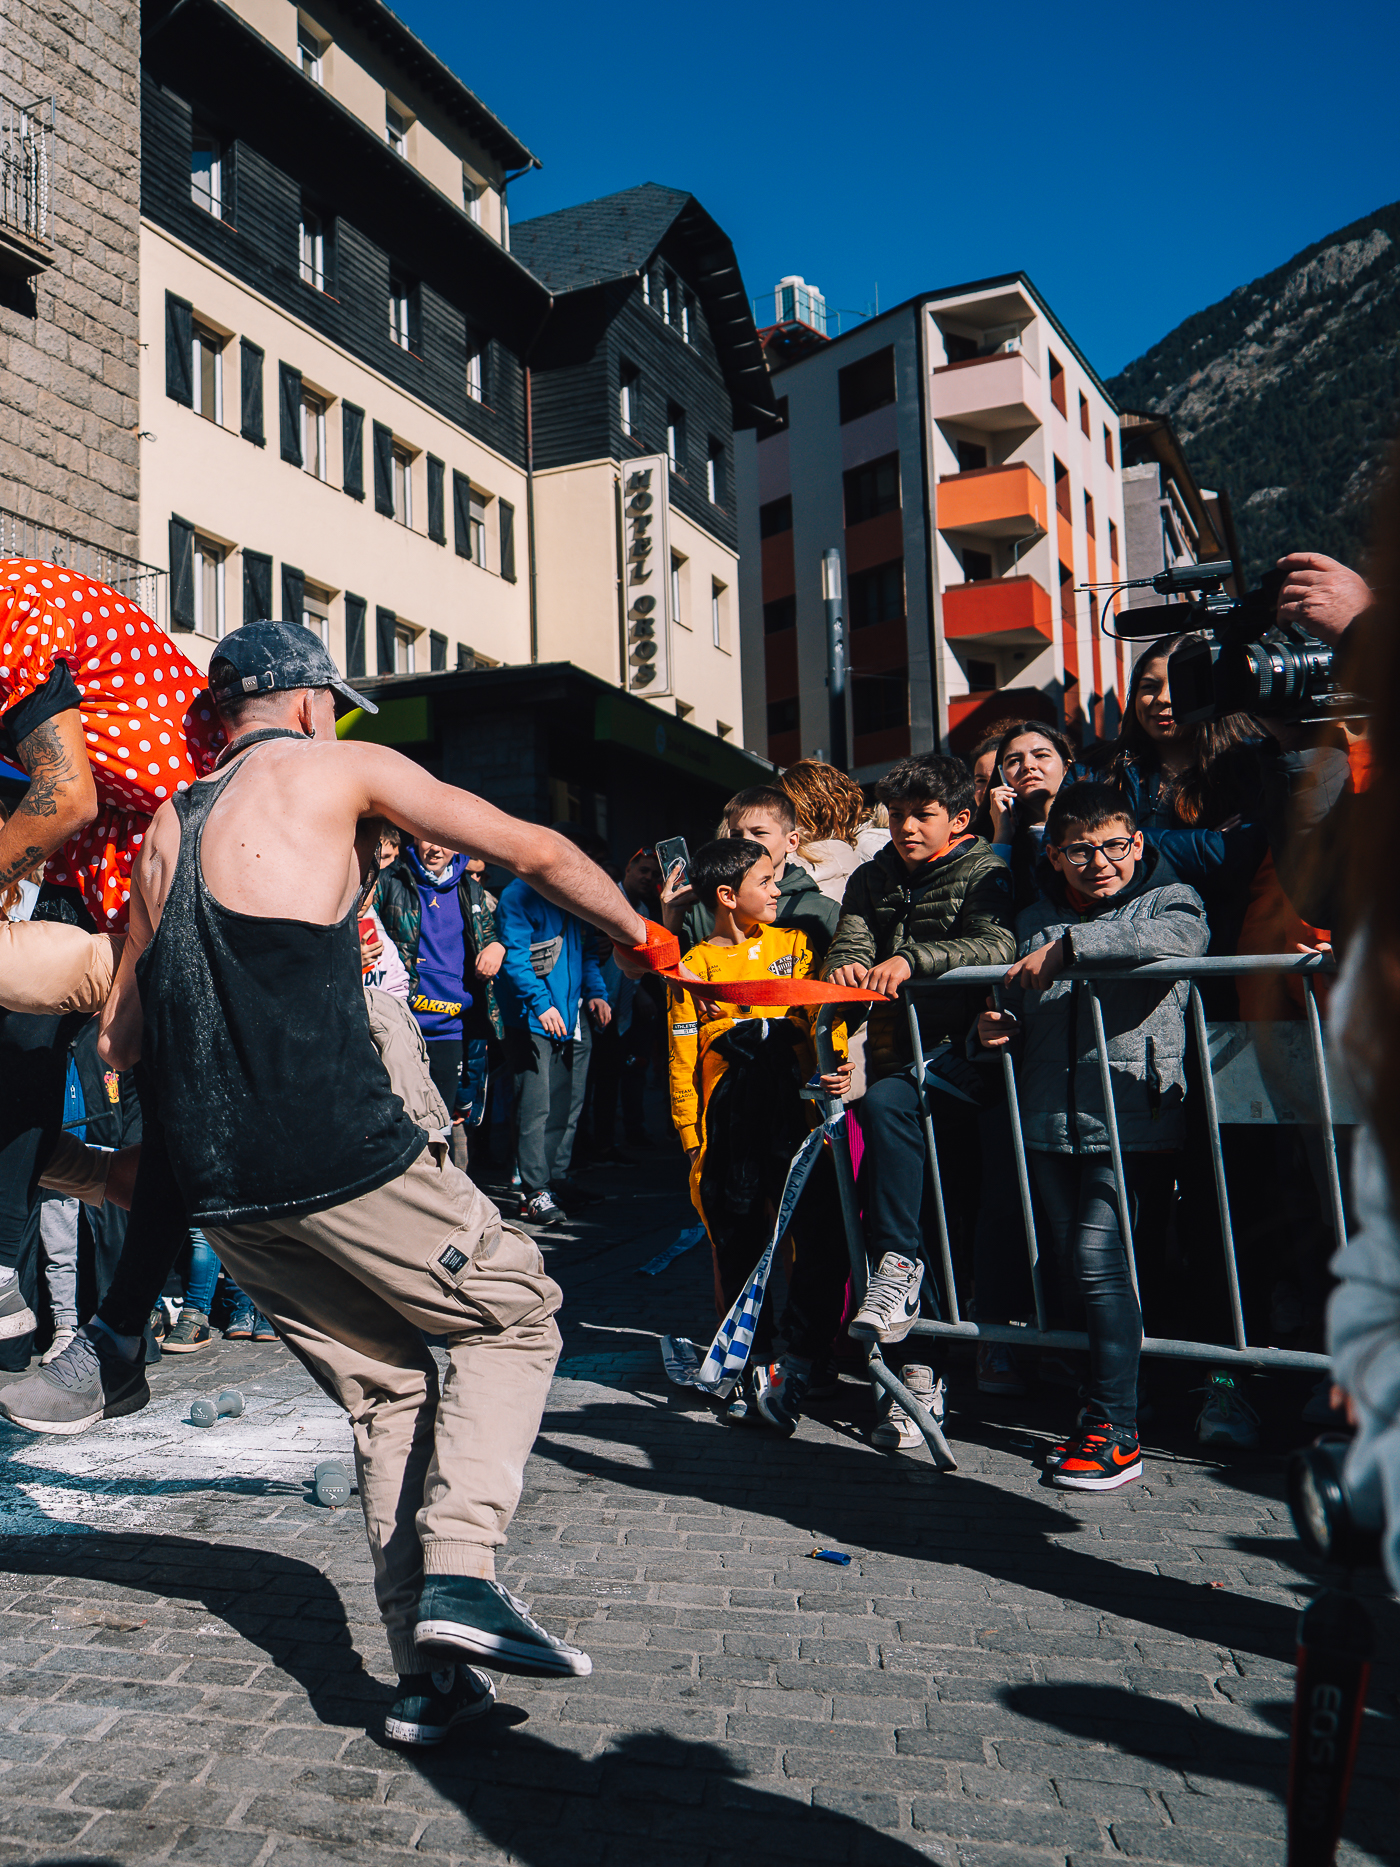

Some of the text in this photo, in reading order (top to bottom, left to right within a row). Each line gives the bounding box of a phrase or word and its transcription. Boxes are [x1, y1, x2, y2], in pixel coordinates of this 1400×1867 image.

[627, 468, 658, 686] HOTEL OROS
[413, 994, 463, 1017] LAKERS
[1307, 1683, 1343, 1766] EOS
